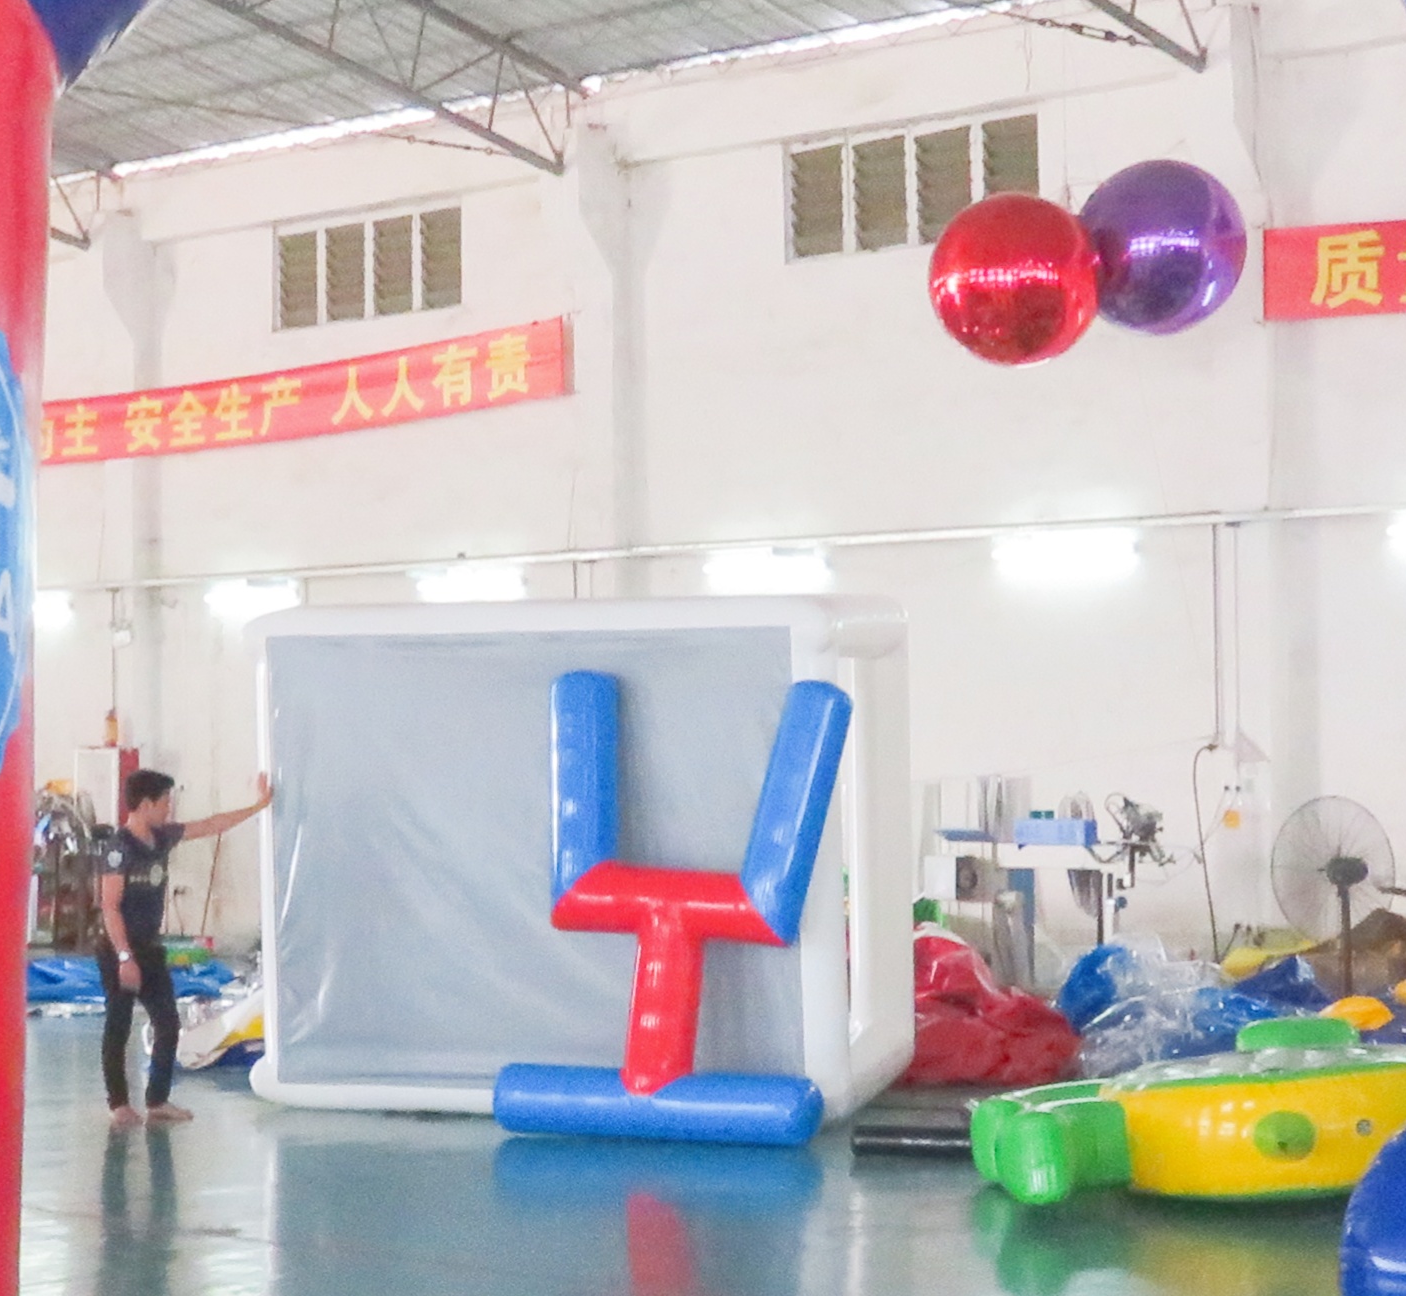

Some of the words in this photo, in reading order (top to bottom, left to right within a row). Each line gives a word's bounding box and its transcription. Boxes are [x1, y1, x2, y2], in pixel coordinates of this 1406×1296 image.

[124, 377, 302, 452] 安全生产
[331, 333, 531, 425] 人人有责
